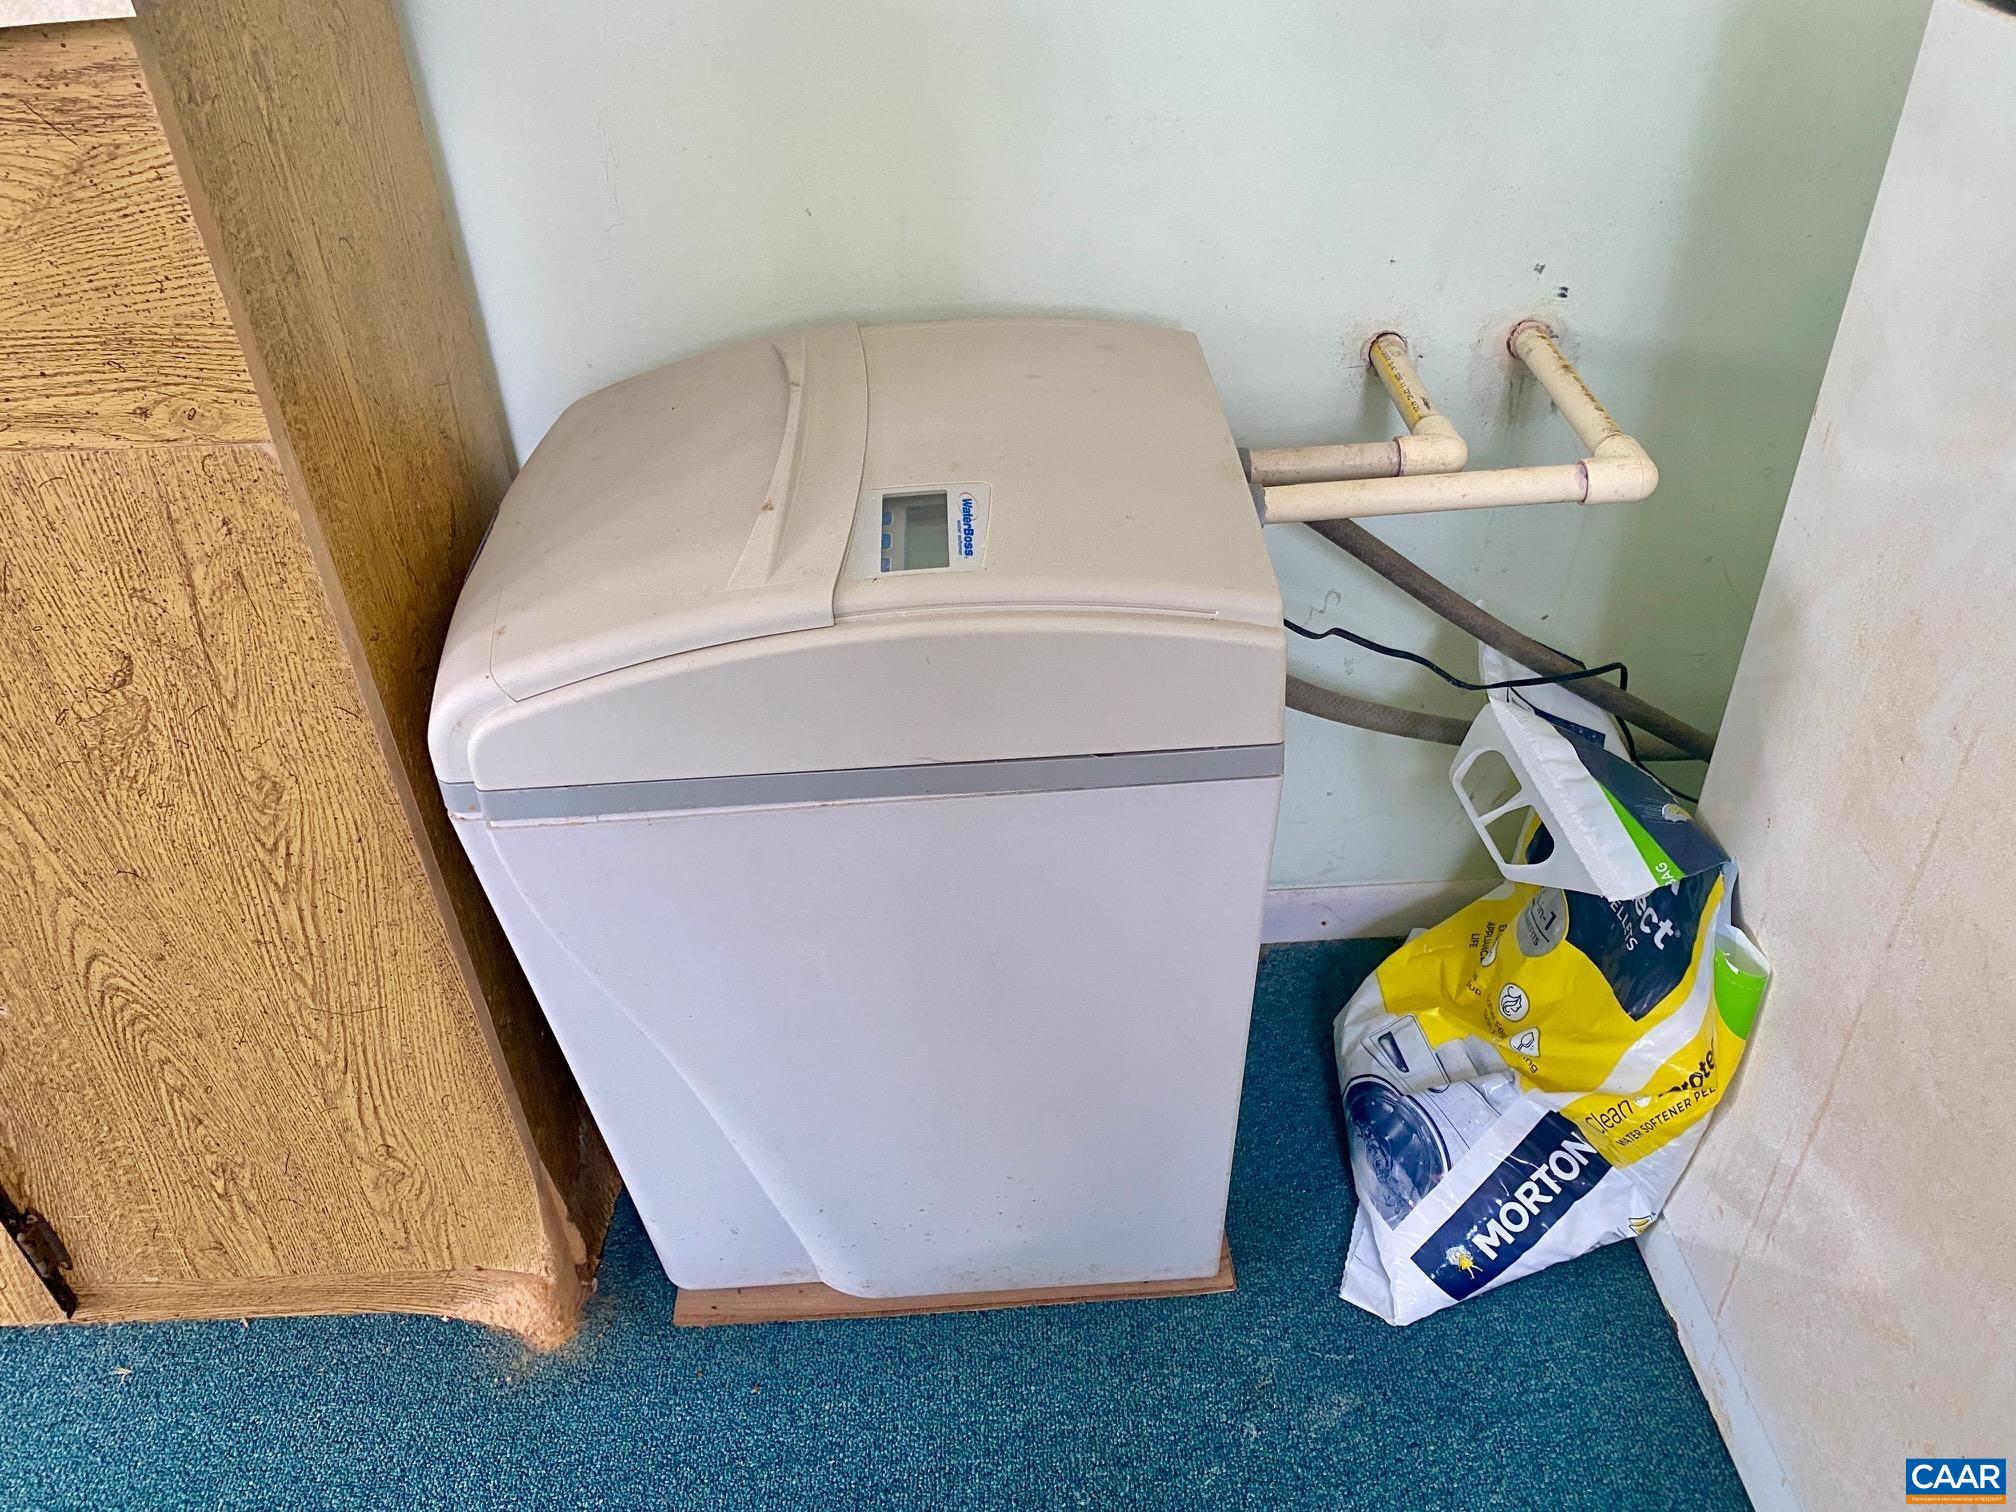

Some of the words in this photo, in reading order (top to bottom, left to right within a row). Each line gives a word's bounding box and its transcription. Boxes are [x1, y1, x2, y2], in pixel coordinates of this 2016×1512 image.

[962, 498, 974, 557] WaterBoss
[1469, 933, 1481, 948] LIFE
[1609, 899, 1638, 951] ELLETS
[1616, 1129, 1642, 1146] WATER
[1640, 1098, 1692, 1133] SOFTENER
[1471, 1131, 1598, 1261] MORTON
